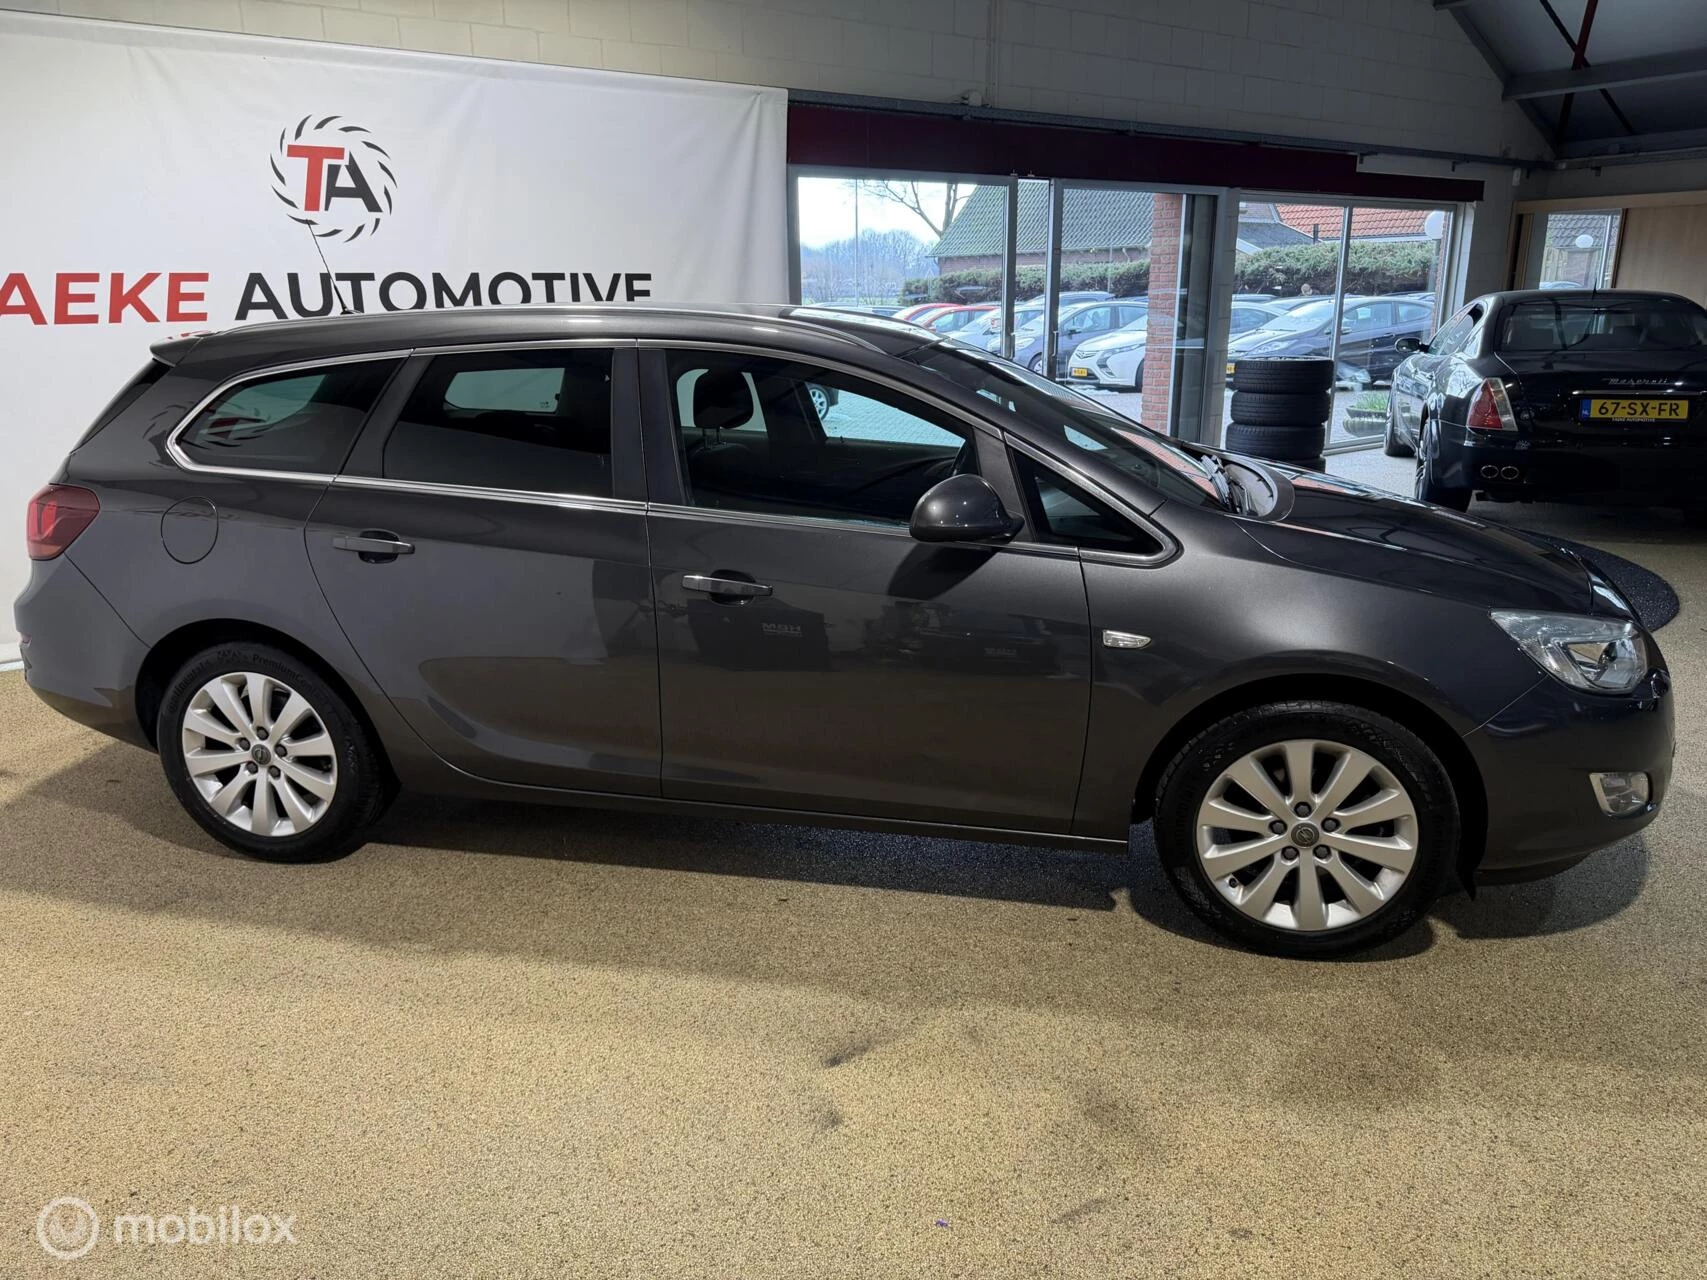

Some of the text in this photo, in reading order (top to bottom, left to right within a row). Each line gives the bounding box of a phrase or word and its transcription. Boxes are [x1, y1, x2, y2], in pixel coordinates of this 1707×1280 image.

[287, 144, 382, 212] TA
[0, 272, 652, 324] AEKE AUTOMOTIVE
[1598, 401, 1680, 416] 67-SX-FR
